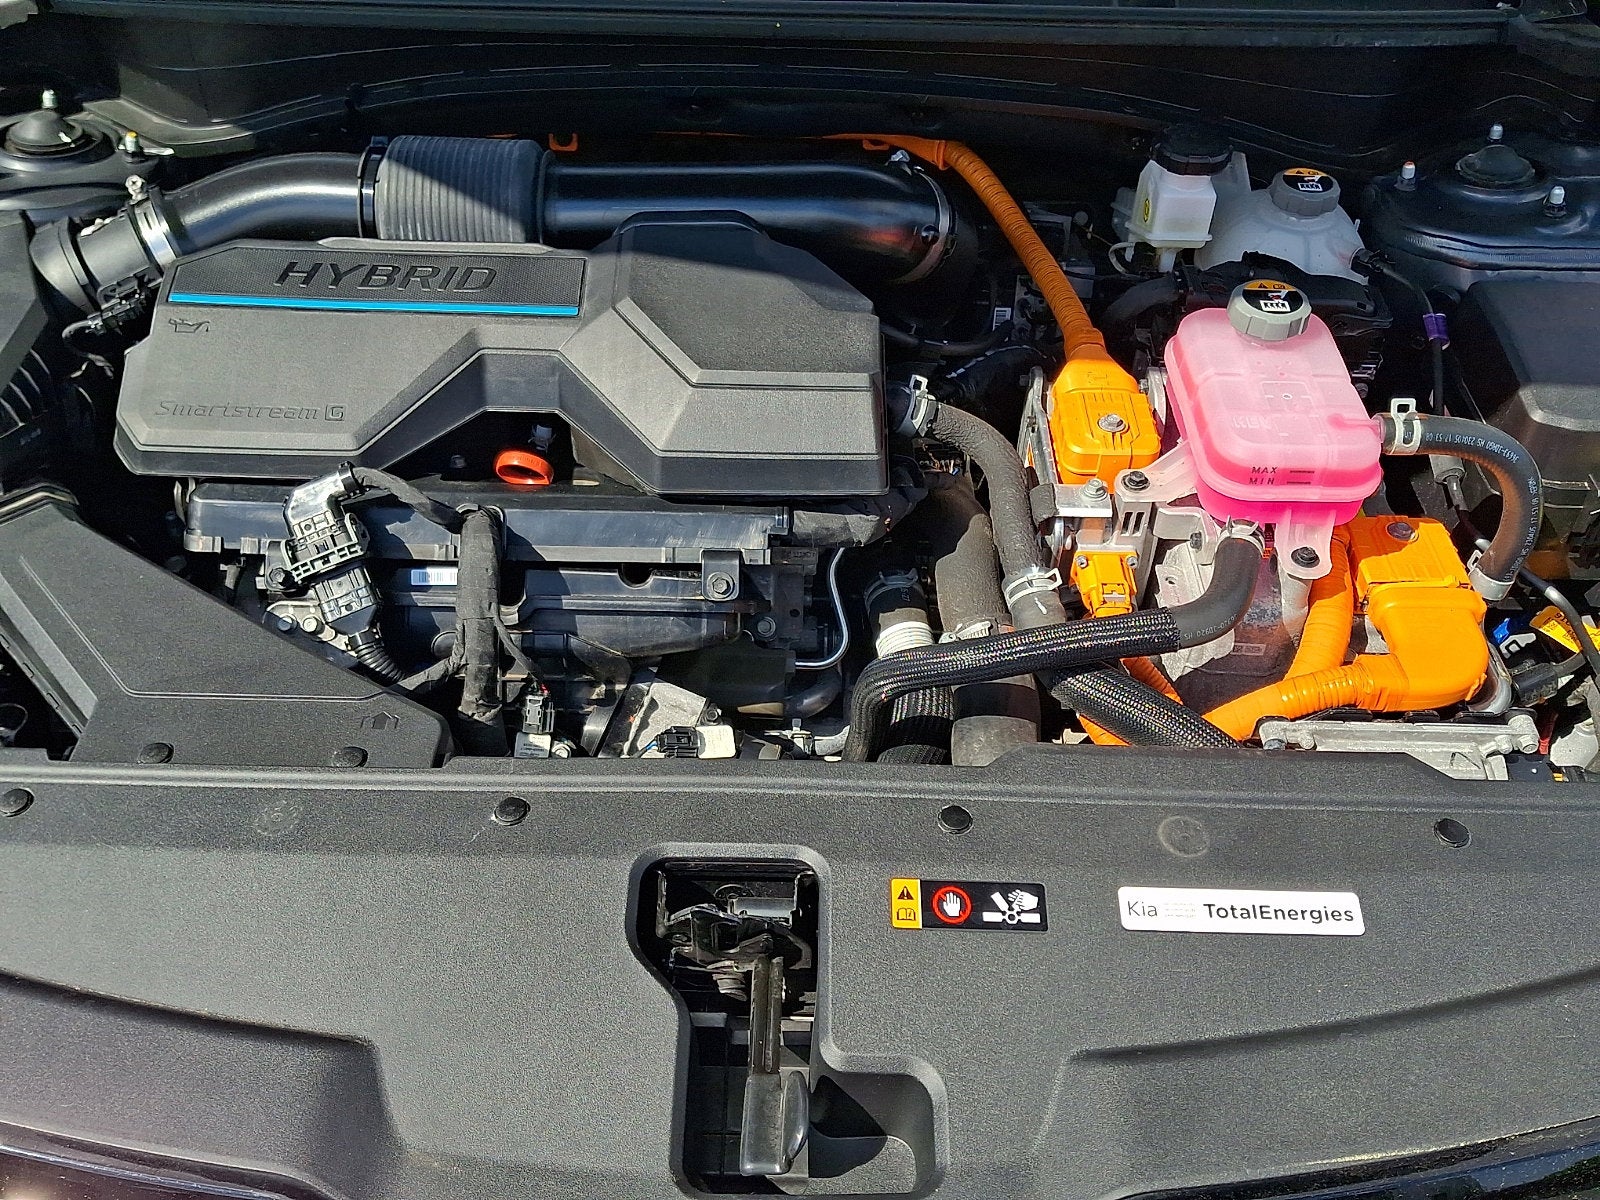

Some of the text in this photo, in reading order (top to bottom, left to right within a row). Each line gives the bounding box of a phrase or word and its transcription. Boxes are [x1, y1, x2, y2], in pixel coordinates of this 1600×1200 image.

[273, 261, 498, 292] HYBRID
[155, 400, 318, 420] Smartstream
[1251, 466, 1278, 475] MAX
[1249, 477, 1275, 486] MIN
[1127, 900, 1158, 917] Kia
[1203, 903, 1354, 924] TotalEnergies
